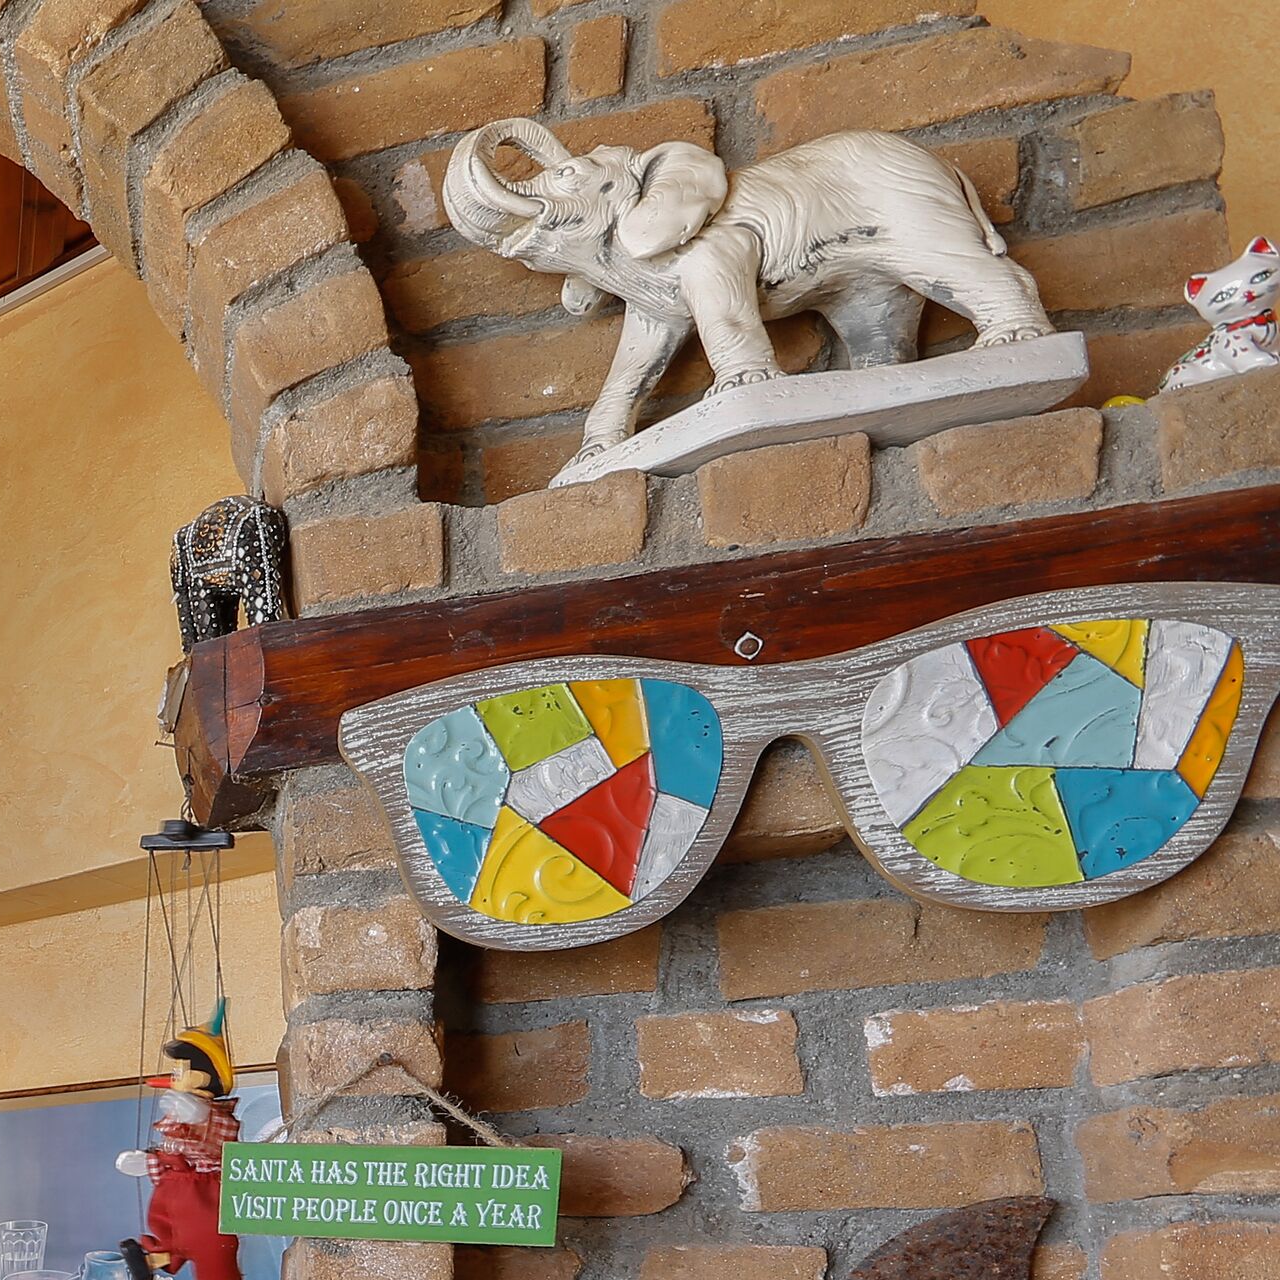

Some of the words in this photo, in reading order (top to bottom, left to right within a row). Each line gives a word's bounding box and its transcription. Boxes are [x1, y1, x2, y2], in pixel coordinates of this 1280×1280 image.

[229, 1159, 305, 1183] SANTA
[310, 1160, 359, 1186] HAS
[363, 1161, 408, 1187] THE
[414, 1163, 486, 1189] RIGHT
[491, 1165, 550, 1191] IDEA
[231, 1192, 287, 1220] VISIT
[291, 1197, 377, 1224] PEOPLE
[383, 1201, 442, 1226] ONCE
[449, 1202, 468, 1228] A
[475, 1199, 542, 1230] YEAR
